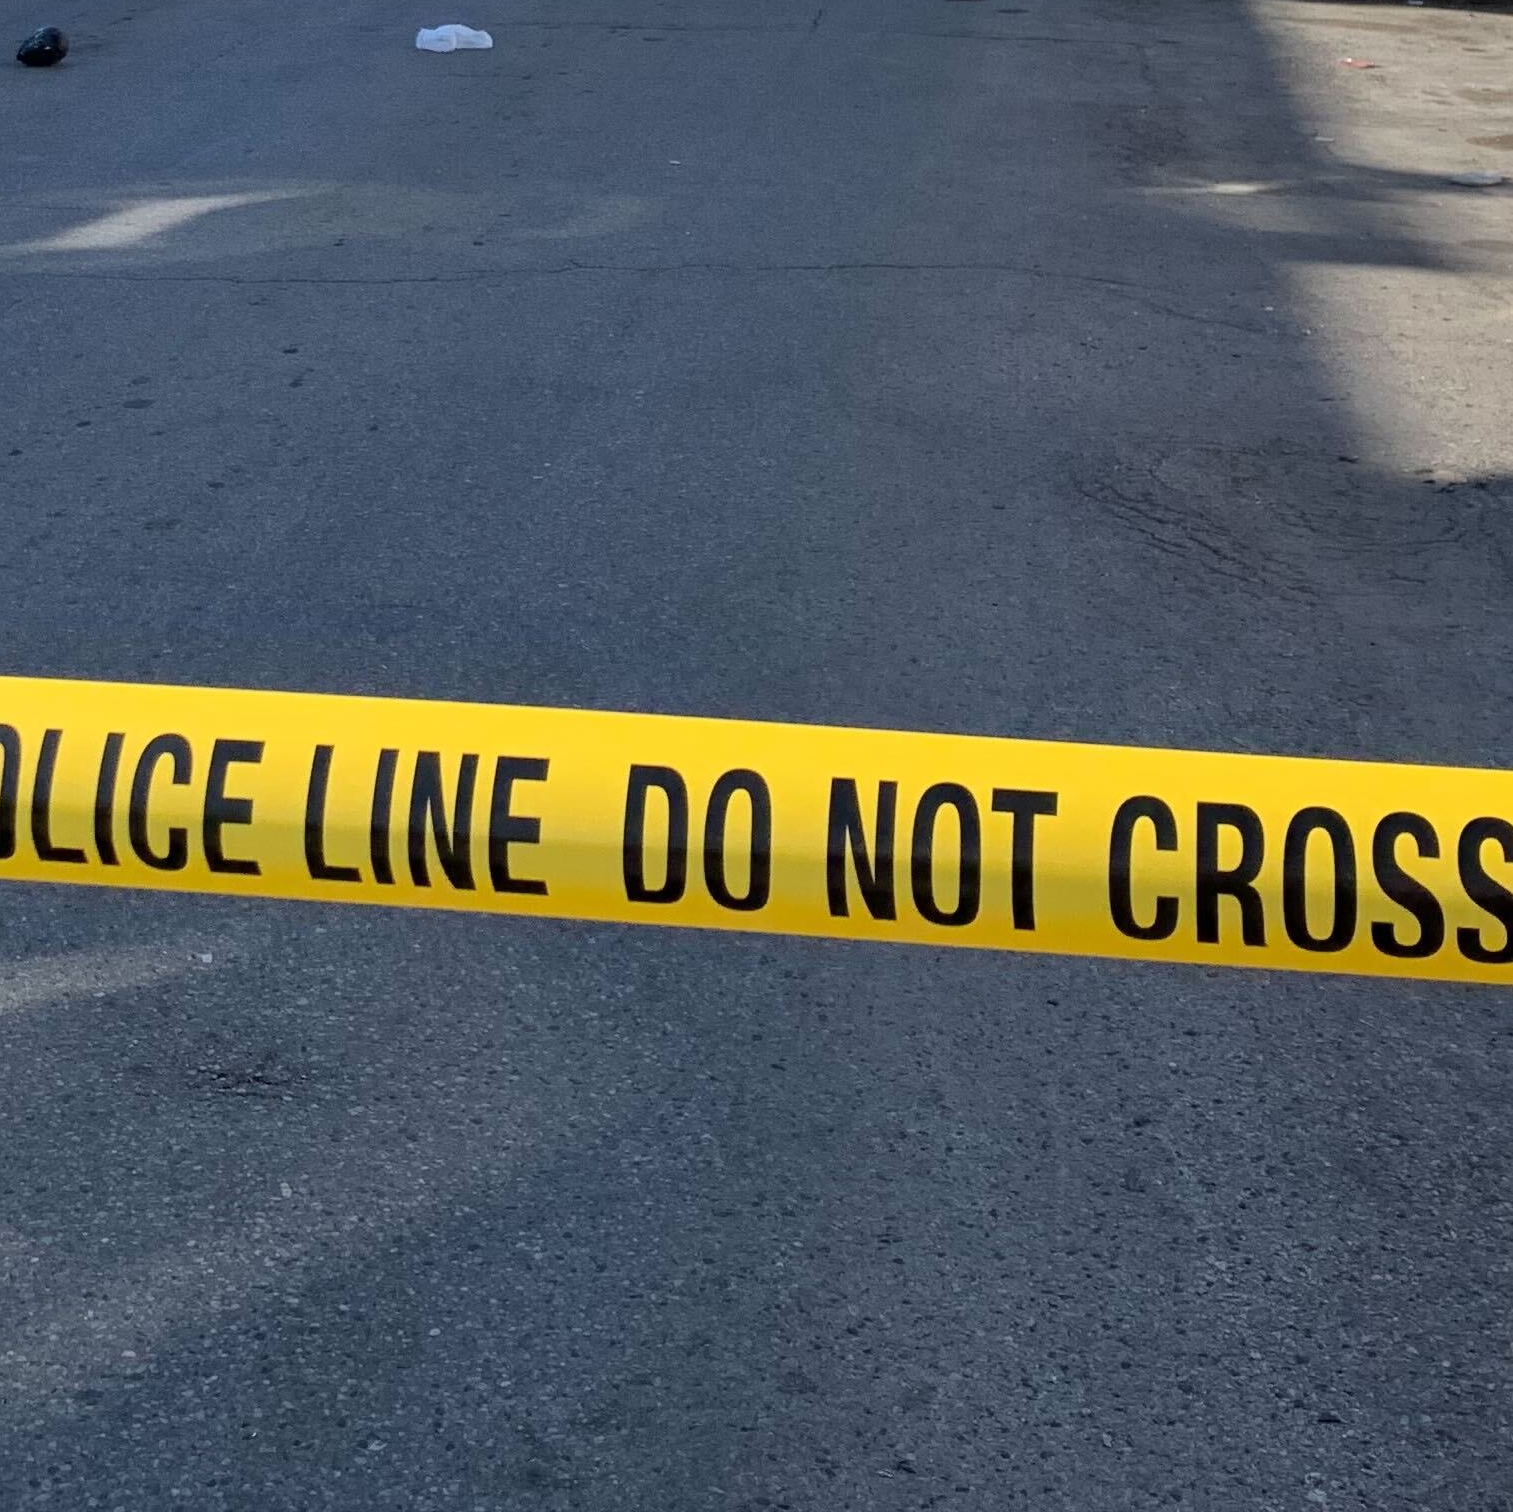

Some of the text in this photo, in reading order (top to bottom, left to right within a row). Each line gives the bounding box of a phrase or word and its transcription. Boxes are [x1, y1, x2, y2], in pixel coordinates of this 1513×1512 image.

[303, 745, 549, 896] LINE
[622, 765, 772, 912] DO
[826, 778, 1058, 931] NOT
[1108, 795, 1513, 964] CROSS
